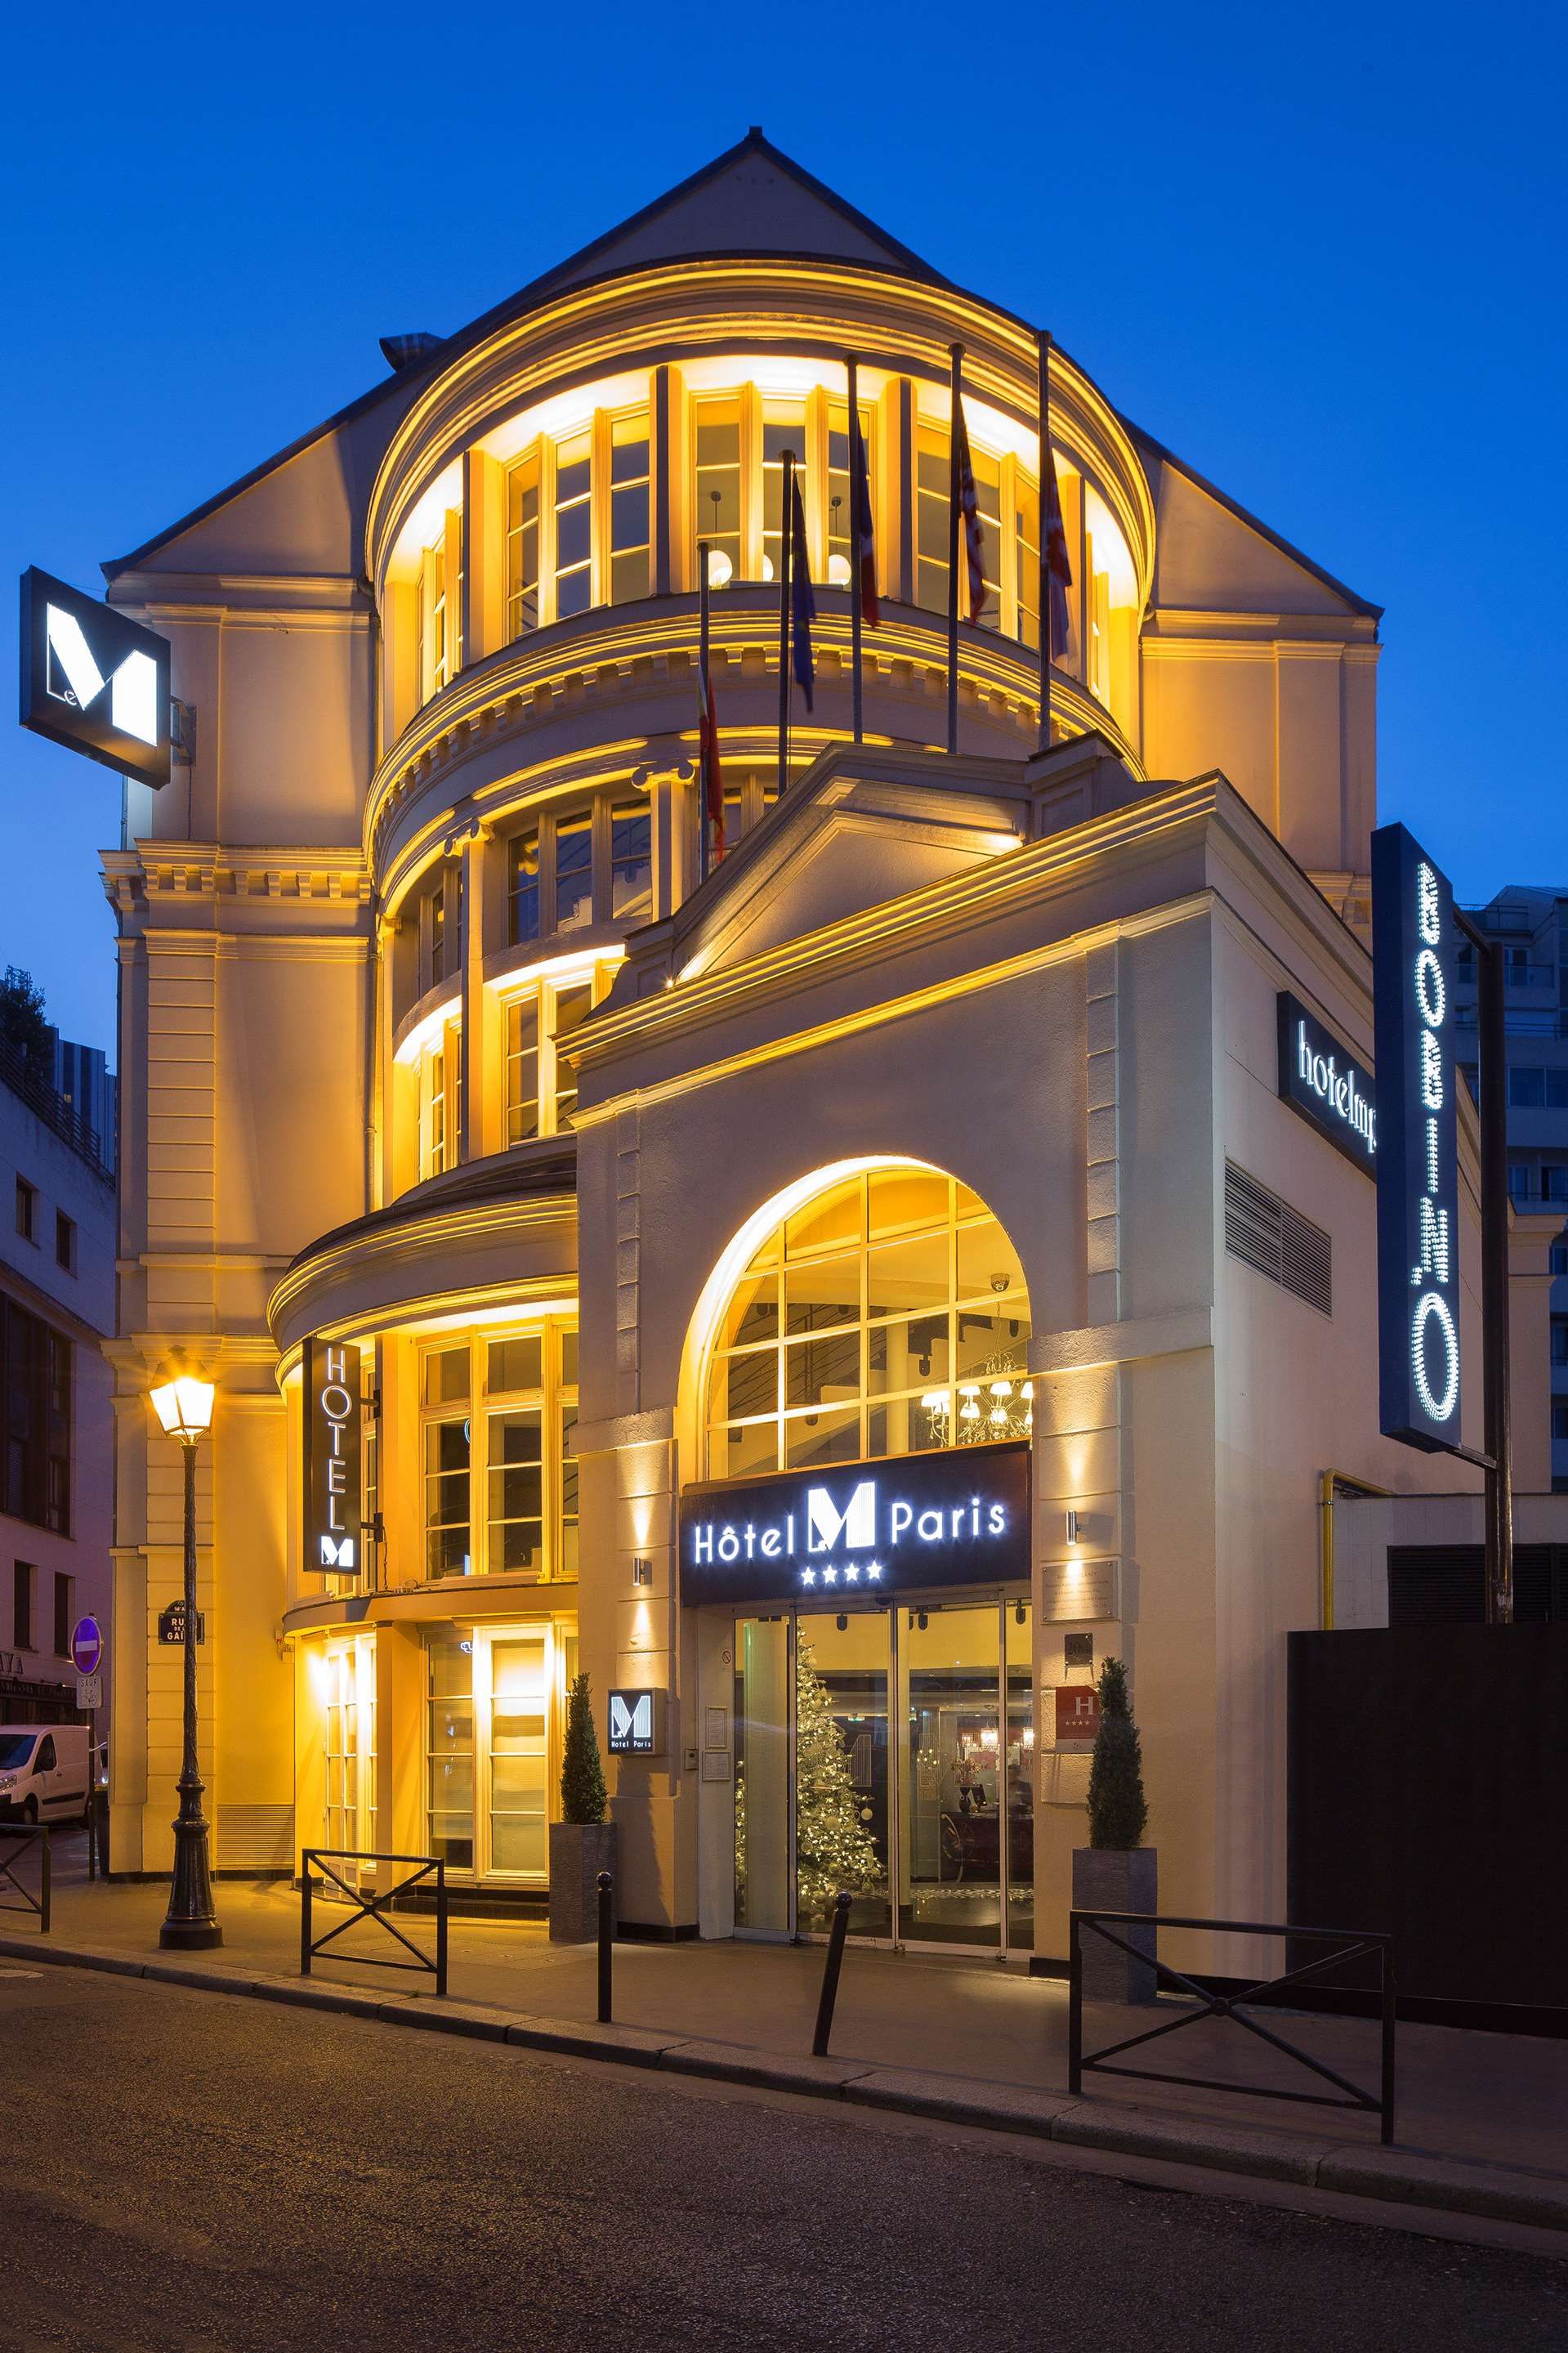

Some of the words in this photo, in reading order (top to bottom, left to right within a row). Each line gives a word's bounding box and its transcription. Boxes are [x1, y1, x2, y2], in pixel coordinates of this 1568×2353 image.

[322, 1347, 352, 1530] HOTEL
[695, 1514, 794, 1563] Hôtel
[891, 1497, 1006, 1544] Paris
[172, 1618, 185, 1626] RU
[167, 1631, 184, 1640] GAÎ
[81, 1678, 97, 1687] SAUF
[1074, 1696, 1095, 1716] H
